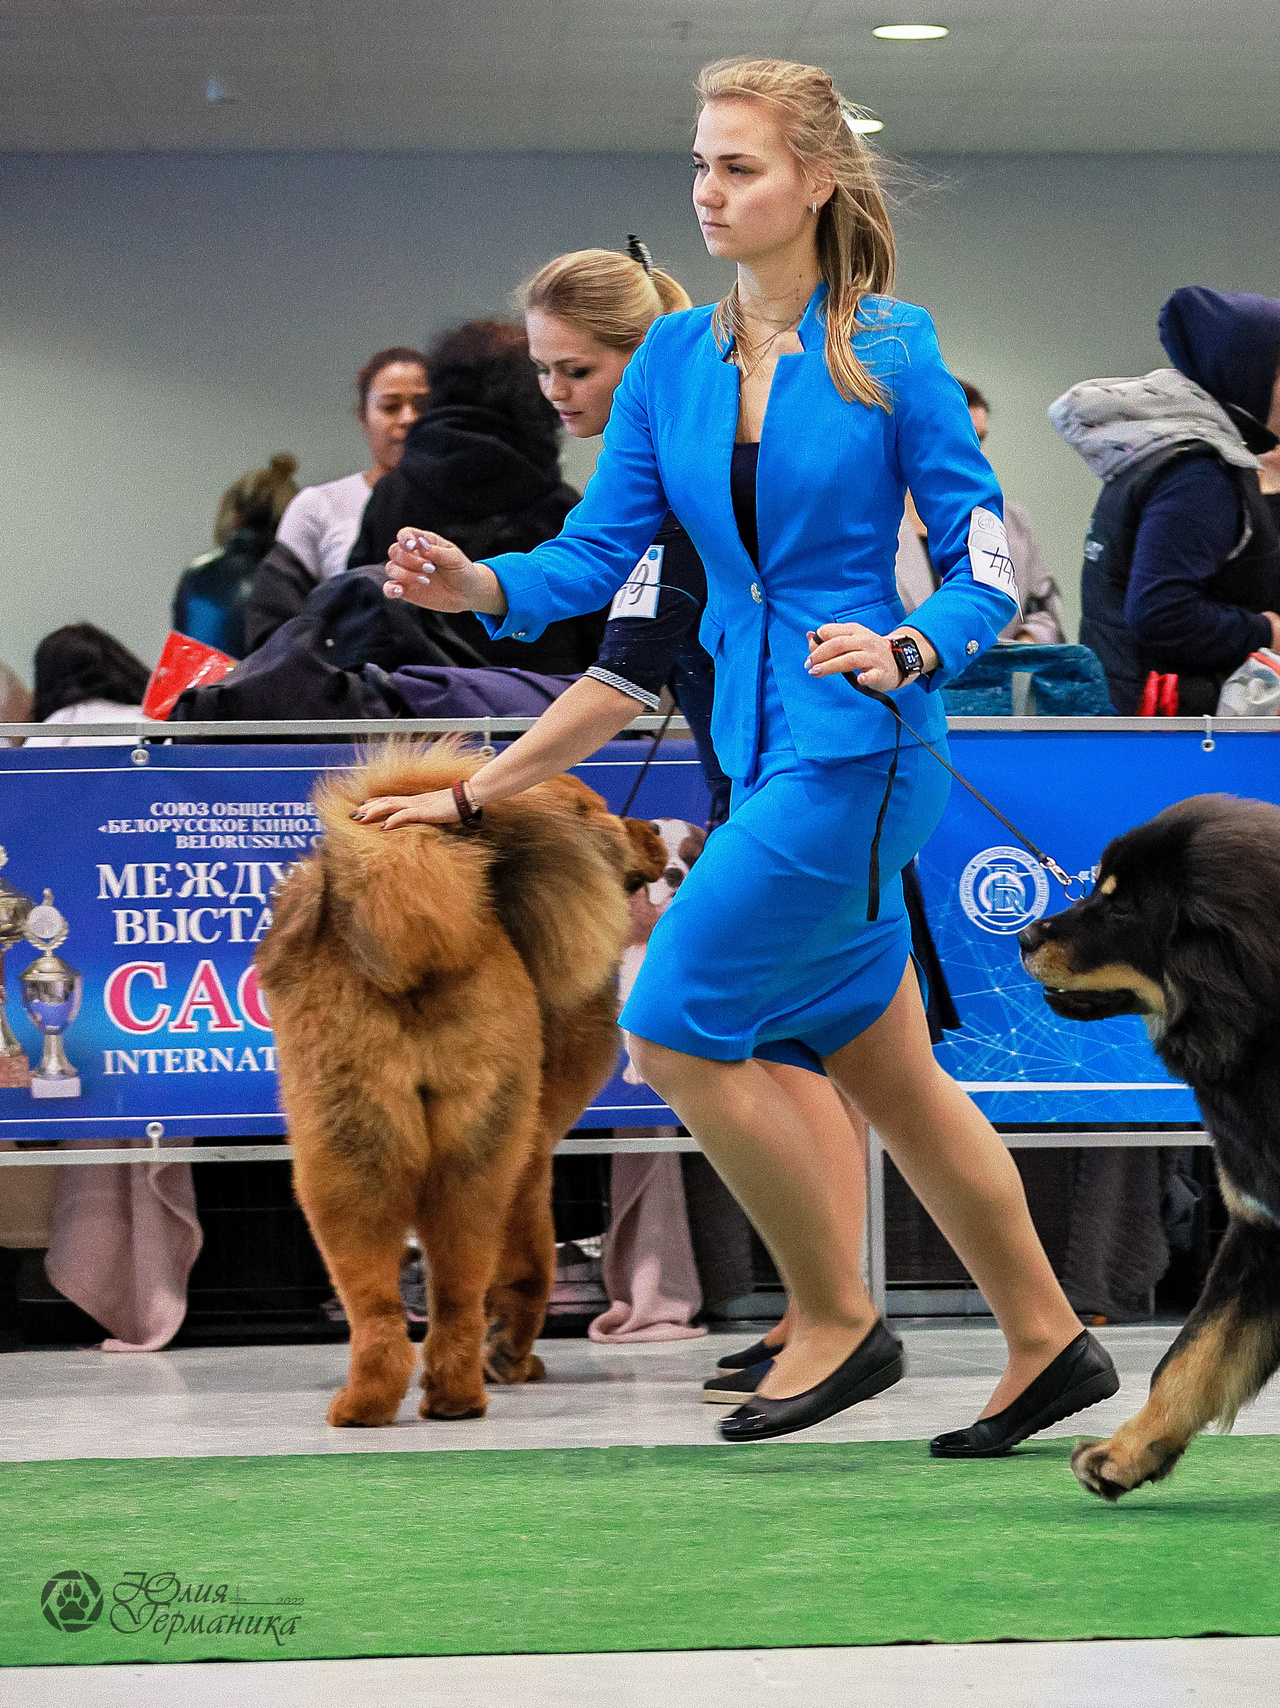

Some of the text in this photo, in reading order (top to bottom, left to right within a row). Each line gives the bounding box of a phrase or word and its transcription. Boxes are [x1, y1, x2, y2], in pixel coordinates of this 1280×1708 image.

[150, 802, 210, 817] СОЮЗ
[98, 819, 250, 834] «БЕЛОРУССКОЕ
[175, 834, 306, 849] BELORUSSIAN
[102, 1047, 279, 1076] INTERNAT
